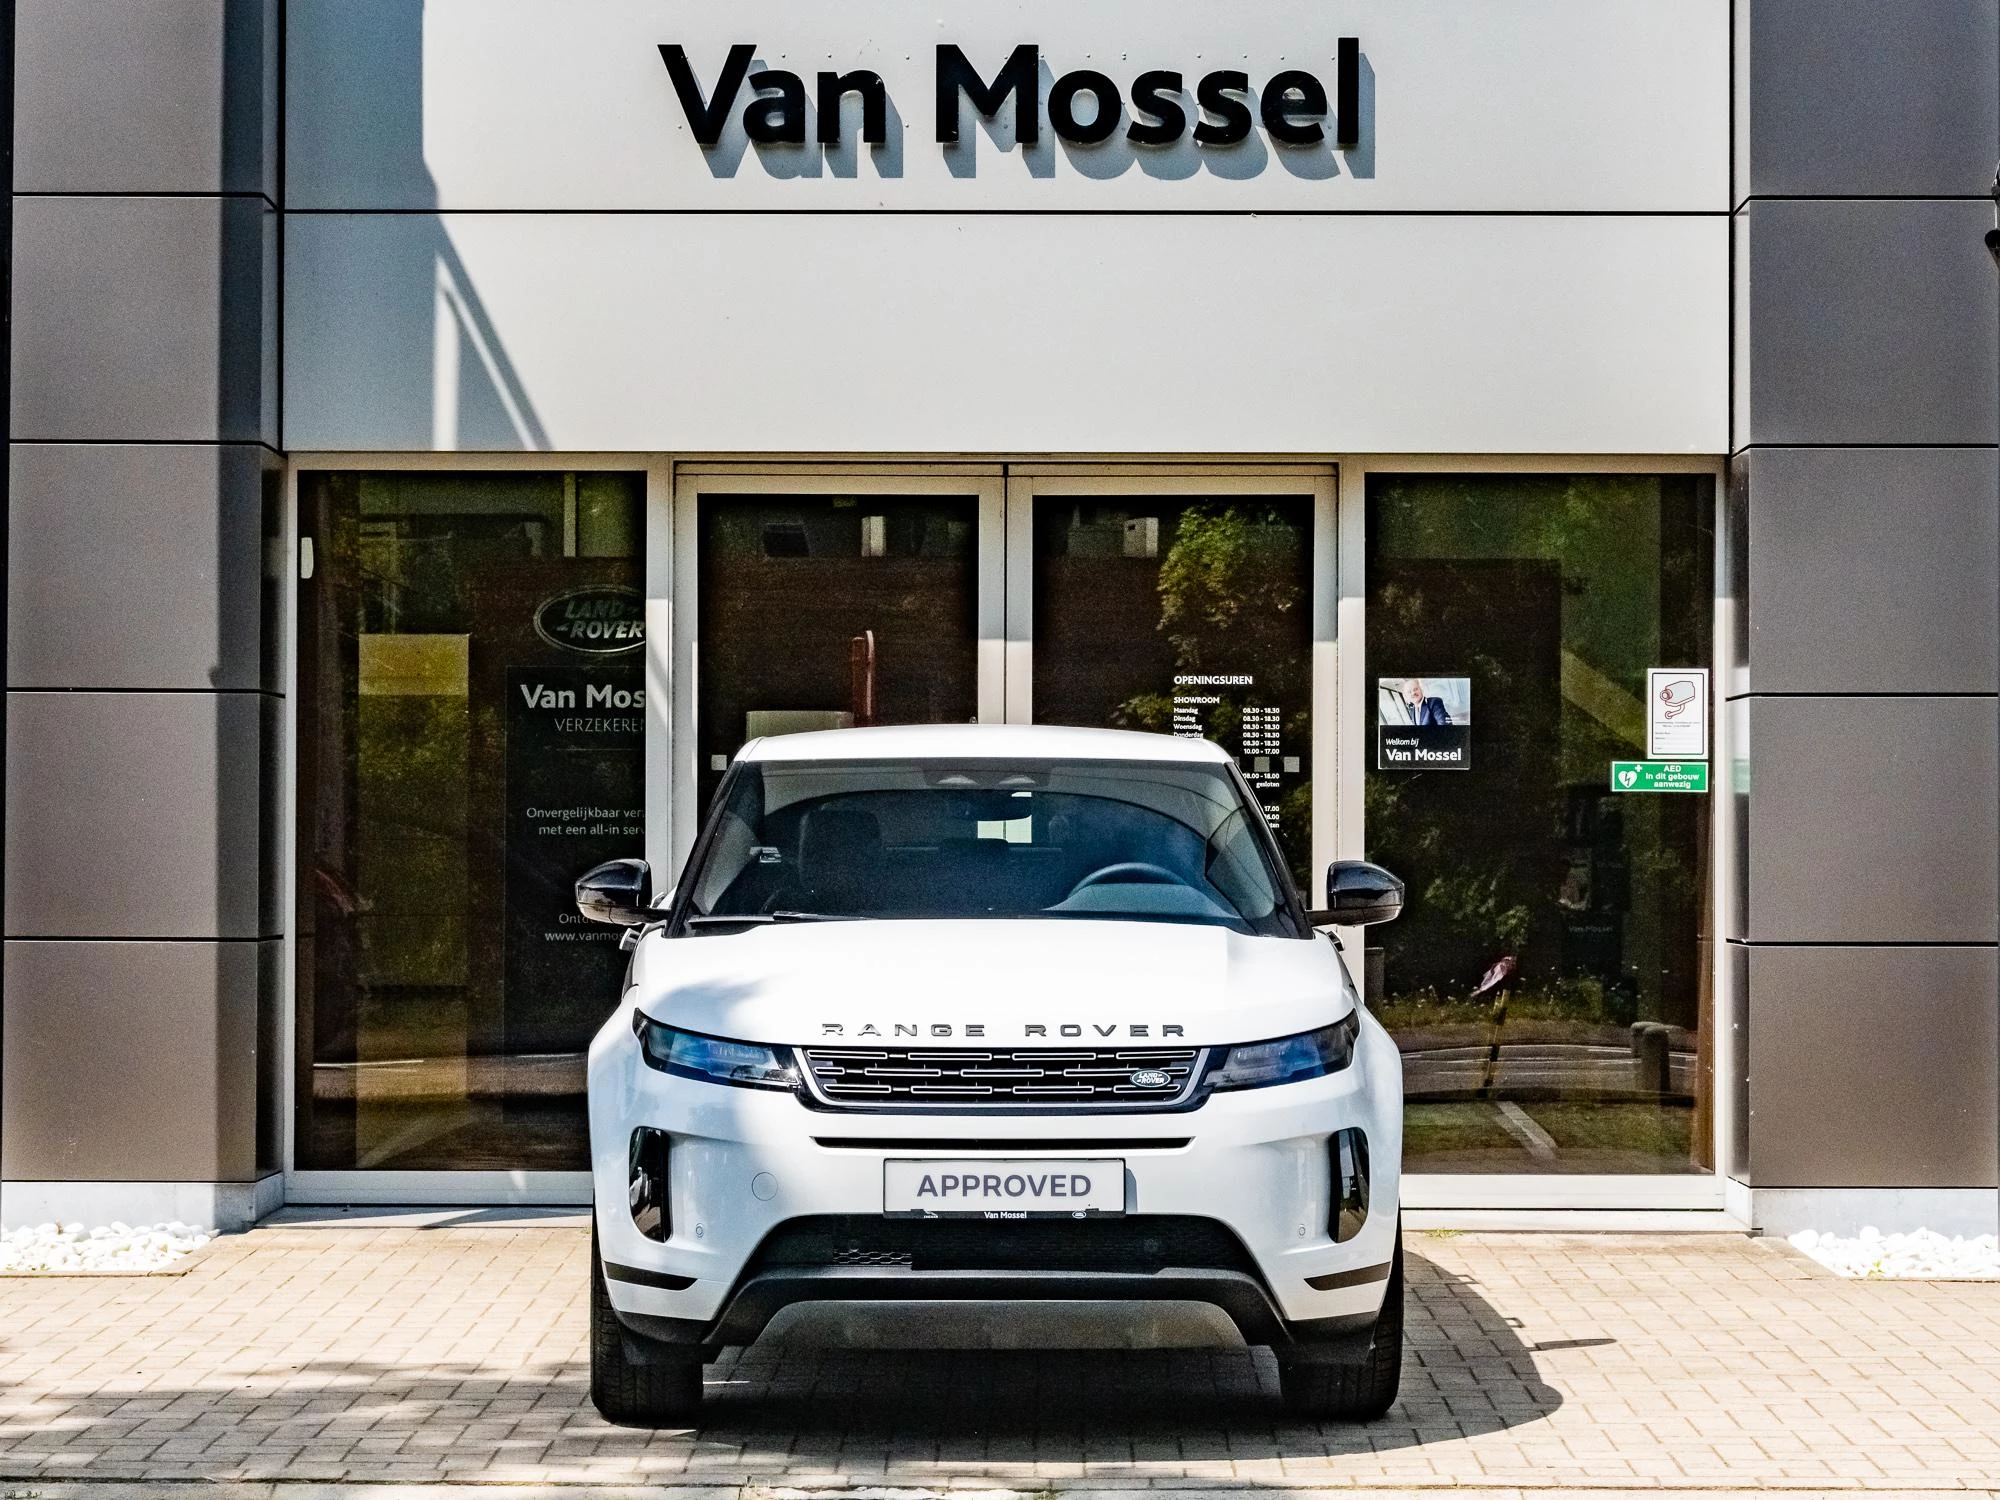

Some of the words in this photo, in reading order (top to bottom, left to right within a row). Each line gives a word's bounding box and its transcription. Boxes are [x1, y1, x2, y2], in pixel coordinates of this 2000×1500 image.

[657, 44, 886, 145] Van
[936, 37, 1360, 146] Mossel
[565, 600, 624, 619] LAND
[570, 620, 646, 639] ROVER
[1173, 676, 1253, 685] OPENINGSUREN
[520, 684, 576, 709] Van
[586, 684, 646, 709] Mos
[1173, 707, 1199, 715] Maandag
[1173, 715, 1196, 723] Dinsdag
[1173, 723, 1203, 731] Woensdag
[1385, 738, 1410, 746] Welkom
[1410, 738, 1420, 748] bij
[1385, 748, 1411, 761] Van
[1415, 748, 1462, 761] Mossel
[1668, 773, 1700, 781] gebouw
[1256, 781, 1280, 789] gesloten
[1653, 780, 1691, 789] aanwezig
[526, 806, 620, 821] Onvergelijkbaar
[623, 808, 645, 818] ver
[538, 825, 563, 835] met
[565, 826, 587, 835] een
[589, 824, 620, 835] all-in
[821, 1023, 985, 1037] RANGE
[1024, 1023, 1185, 1037] ROVER
[916, 1174, 1092, 1198] APPROVED
[983, 1211, 999, 1219] Van
[1000, 1211, 1027, 1219] Mossel
